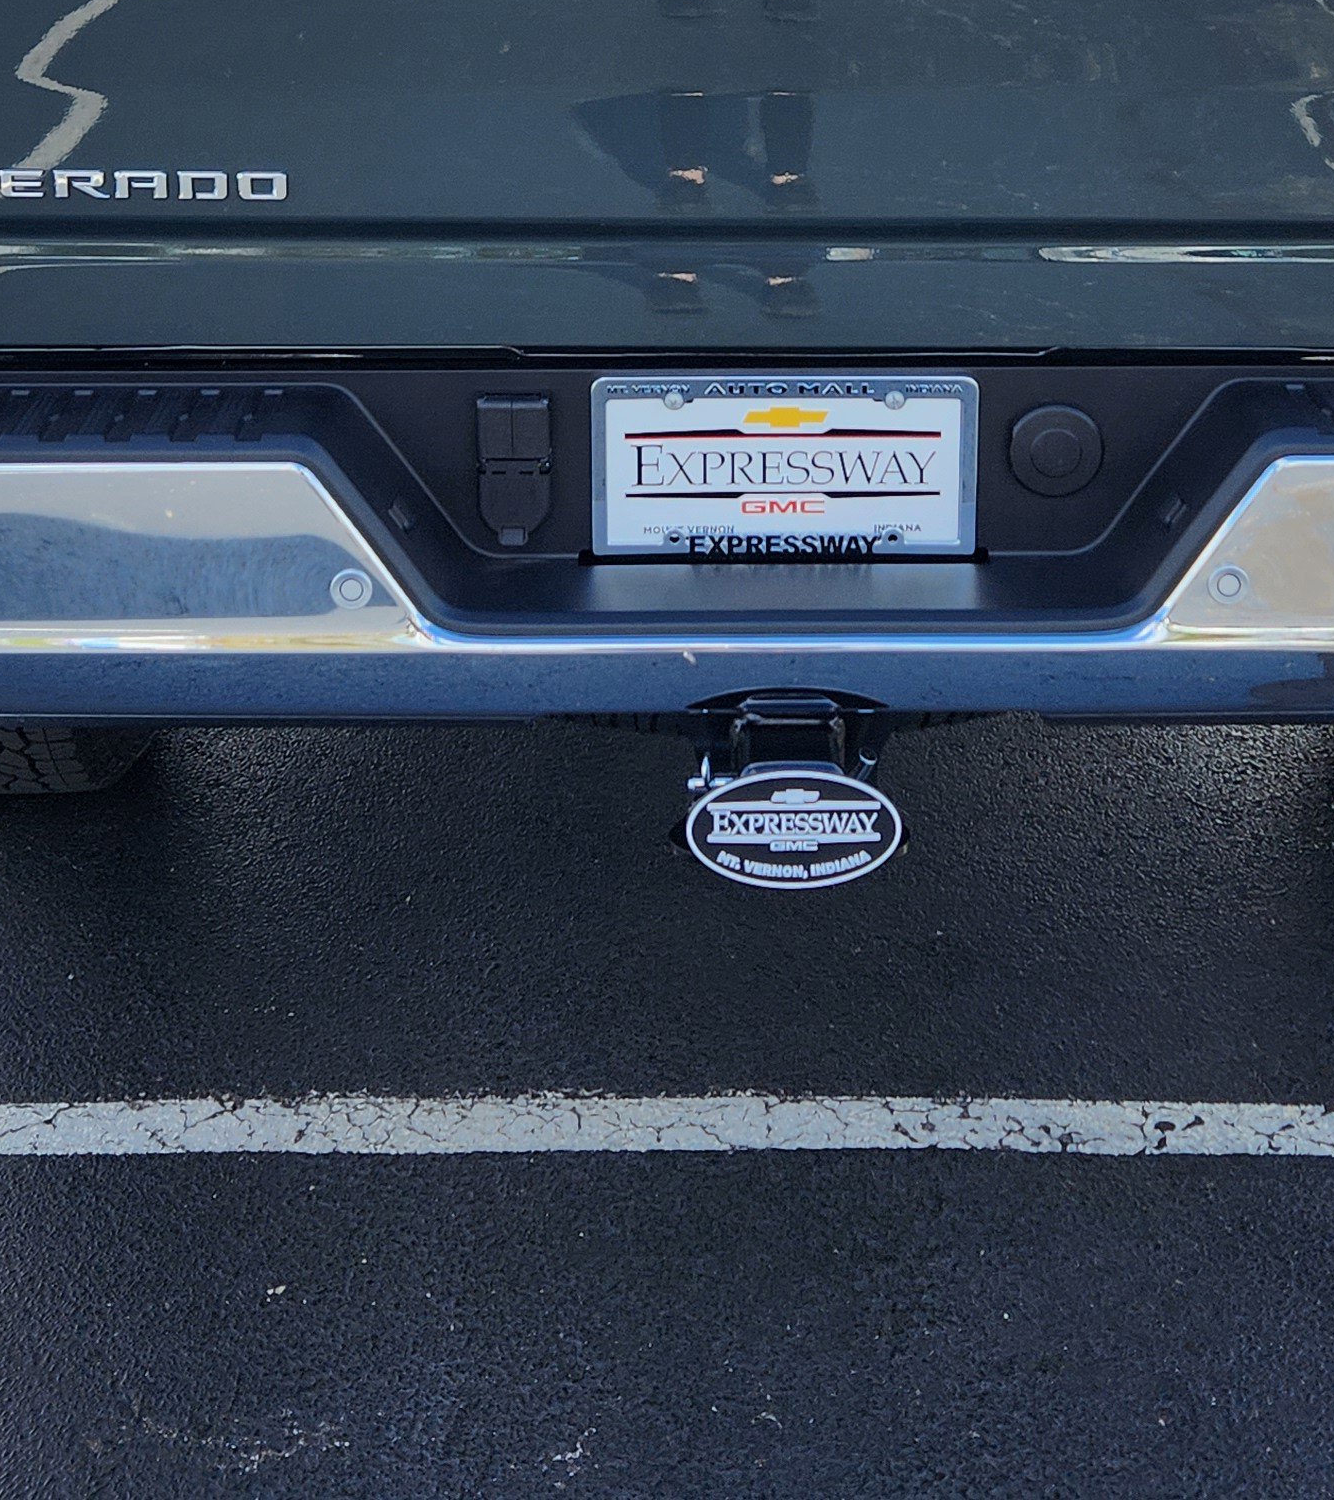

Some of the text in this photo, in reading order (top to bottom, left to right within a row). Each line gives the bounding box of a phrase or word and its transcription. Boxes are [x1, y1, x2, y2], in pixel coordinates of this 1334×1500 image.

[704, 383, 875, 395] AUTO MALL
[905, 384, 963, 393] INDIANA
[630, 444, 936, 487] EXPRESSWAY
[741, 500, 825, 514] GMC
[643, 525, 735, 534] MOU VERNON
[688, 535, 877, 555] EXPRESSWAY
[710, 810, 879, 835] EXPRESSWAY
[769, 840, 819, 852] GMC
[716, 850, 872, 880] MT. VERNON, INDIANA
